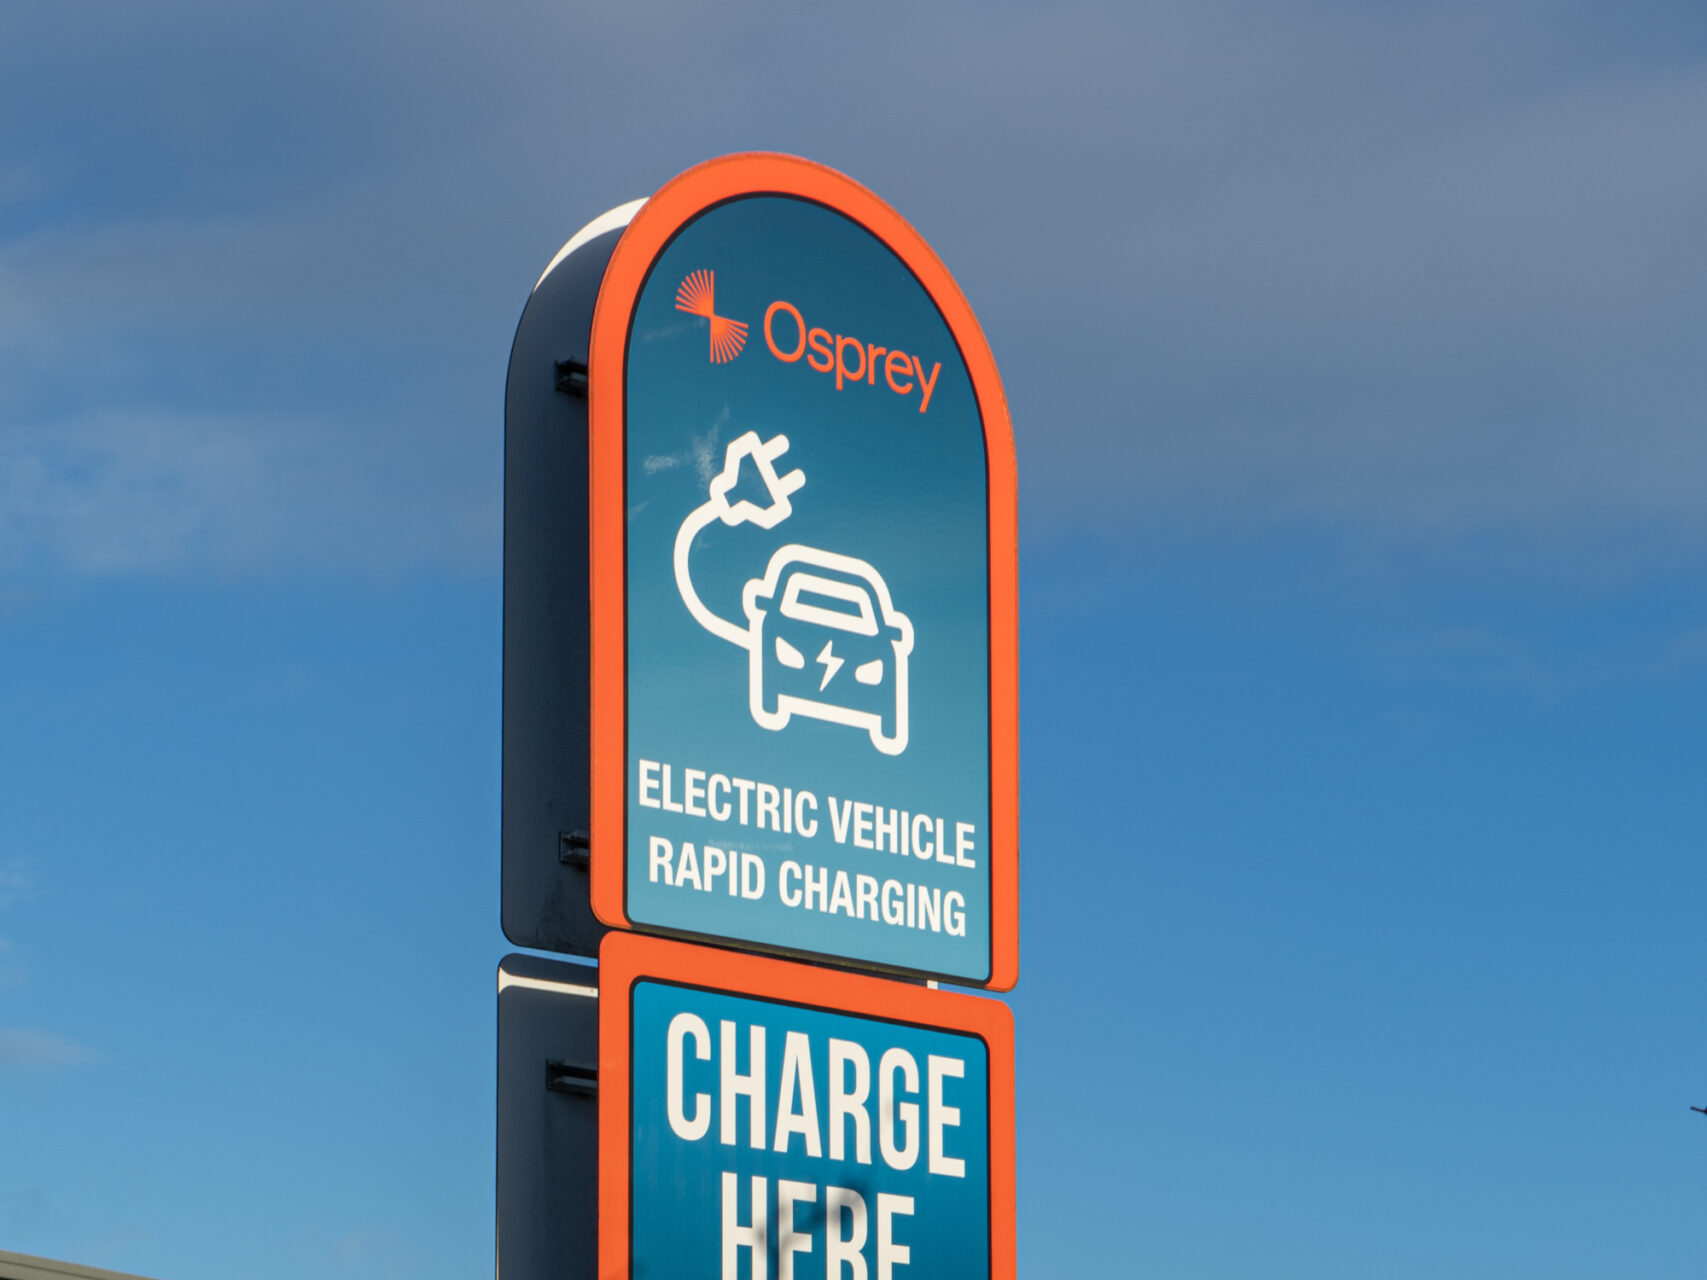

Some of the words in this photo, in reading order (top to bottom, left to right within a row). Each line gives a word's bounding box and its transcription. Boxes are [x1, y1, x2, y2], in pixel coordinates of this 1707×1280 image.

[764, 301, 941, 413] Osprey
[638, 759, 818, 838] ELECTRIC
[828, 796, 976, 868] VEHICLE
[649, 836, 765, 900] RAPID
[779, 861, 966, 937] CHARGING
[667, 1012, 966, 1178] CHARGE
